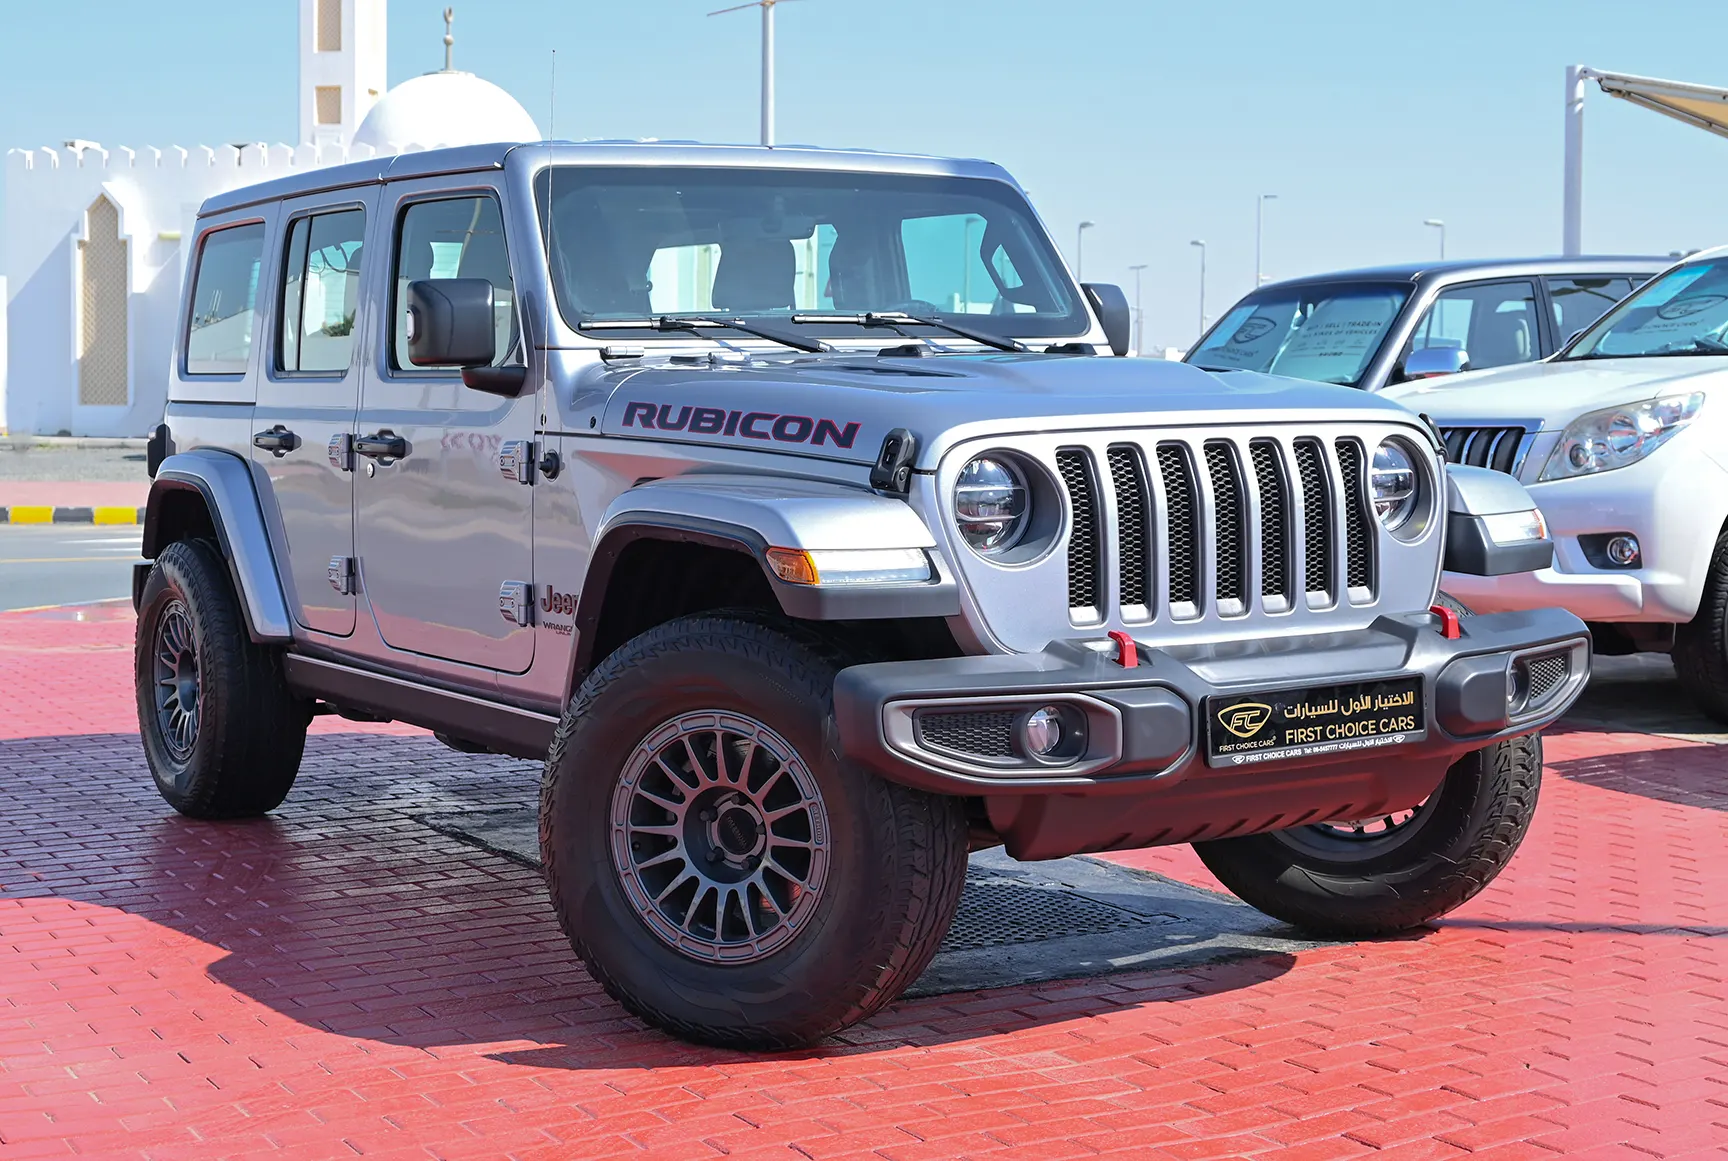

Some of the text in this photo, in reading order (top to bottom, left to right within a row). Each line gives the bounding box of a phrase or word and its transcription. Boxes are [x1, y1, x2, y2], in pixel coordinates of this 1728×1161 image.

[622, 401, 862, 449] RUBICON
[1284, 690, 1414, 720] الاختيار الأول للسيارات
[1285, 715, 1415, 744] FIRST CHOICE CARS
[1219, 744, 1235, 752] FIRST
[1236, 741, 1258, 750] CHOICE
[1246, 753, 1262, 762] FIRST
[1263, 750, 1285, 760] CHOICE
[1285, 748, 1302, 757] CARS
